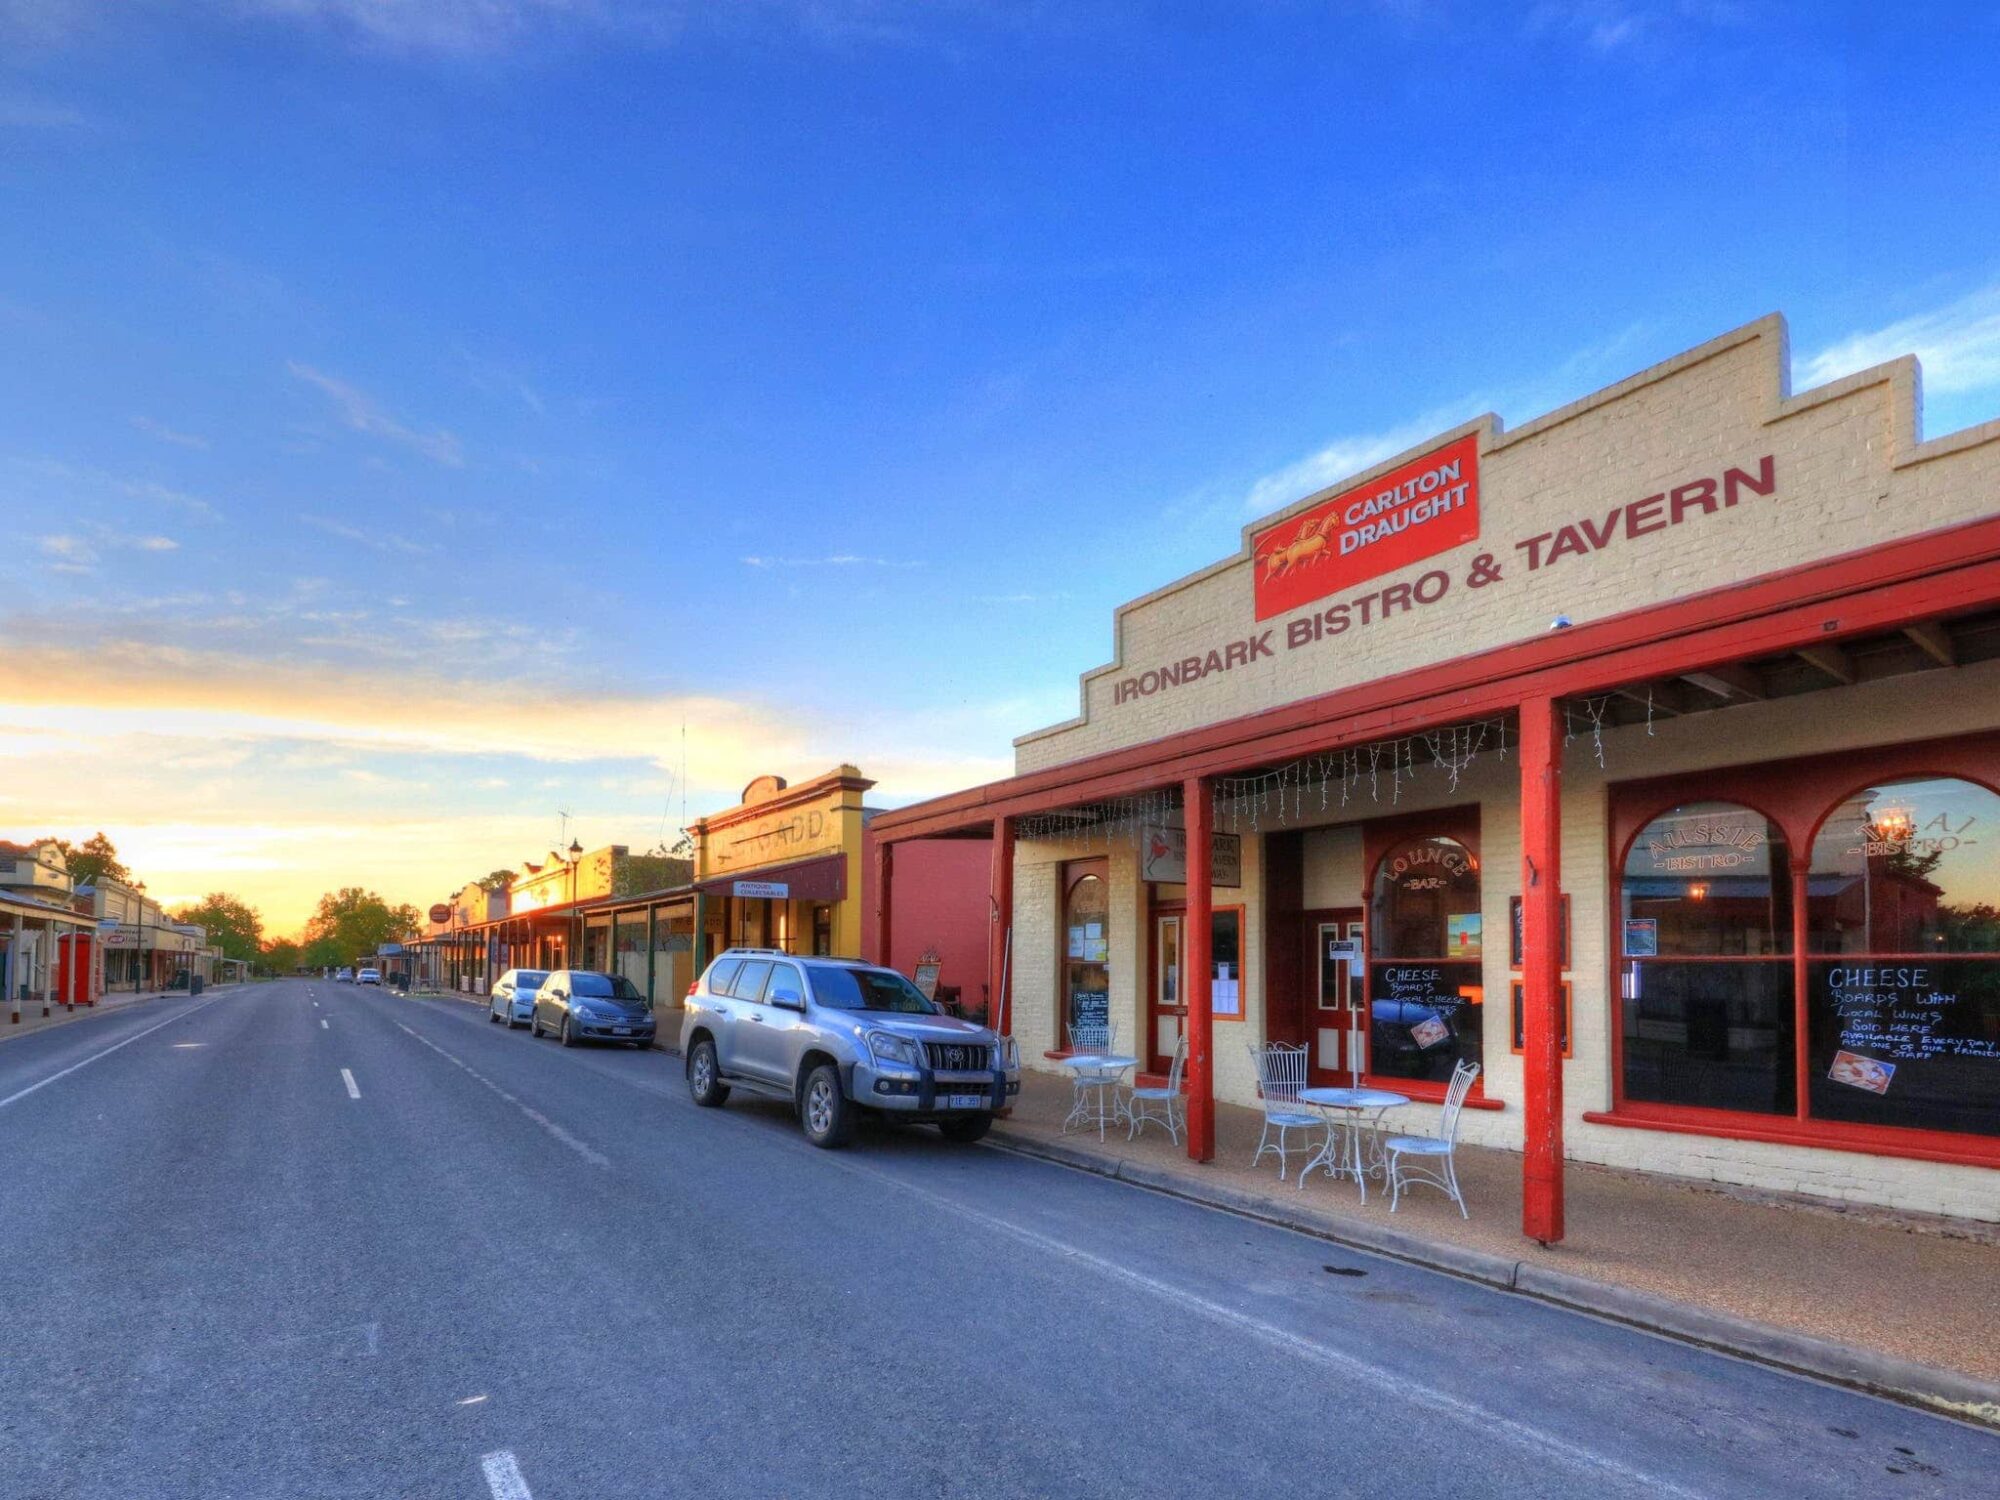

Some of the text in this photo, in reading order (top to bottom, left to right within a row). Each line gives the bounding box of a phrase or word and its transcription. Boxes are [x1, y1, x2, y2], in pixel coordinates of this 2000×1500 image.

[1344, 458, 1462, 526] CARLTON
[1339, 481, 1470, 556] DRAUGHT
[1114, 455, 1775, 705] IRONBARK BISTRO & TAVERN
[1176, 833, 1236, 851] IRARK
[1649, 824, 1767, 859] AUSSIE
[1211, 855, 1238, 866] AVERN
[1383, 847, 1469, 881] LOUNGE
[1385, 968, 1442, 982] CHEESE
[1829, 968, 1929, 988] CHEESE
[1831, 989, 1898, 1007] BOARDS
[1837, 1005, 1942, 1025] LOCAL WINES
[1840, 1031, 1910, 1042] AVAILABLE
[1890, 1024, 1931, 1034] HERE
[1871, 1042, 1890, 1050] ONE
[1889, 1050, 1933, 1059] STAFF
